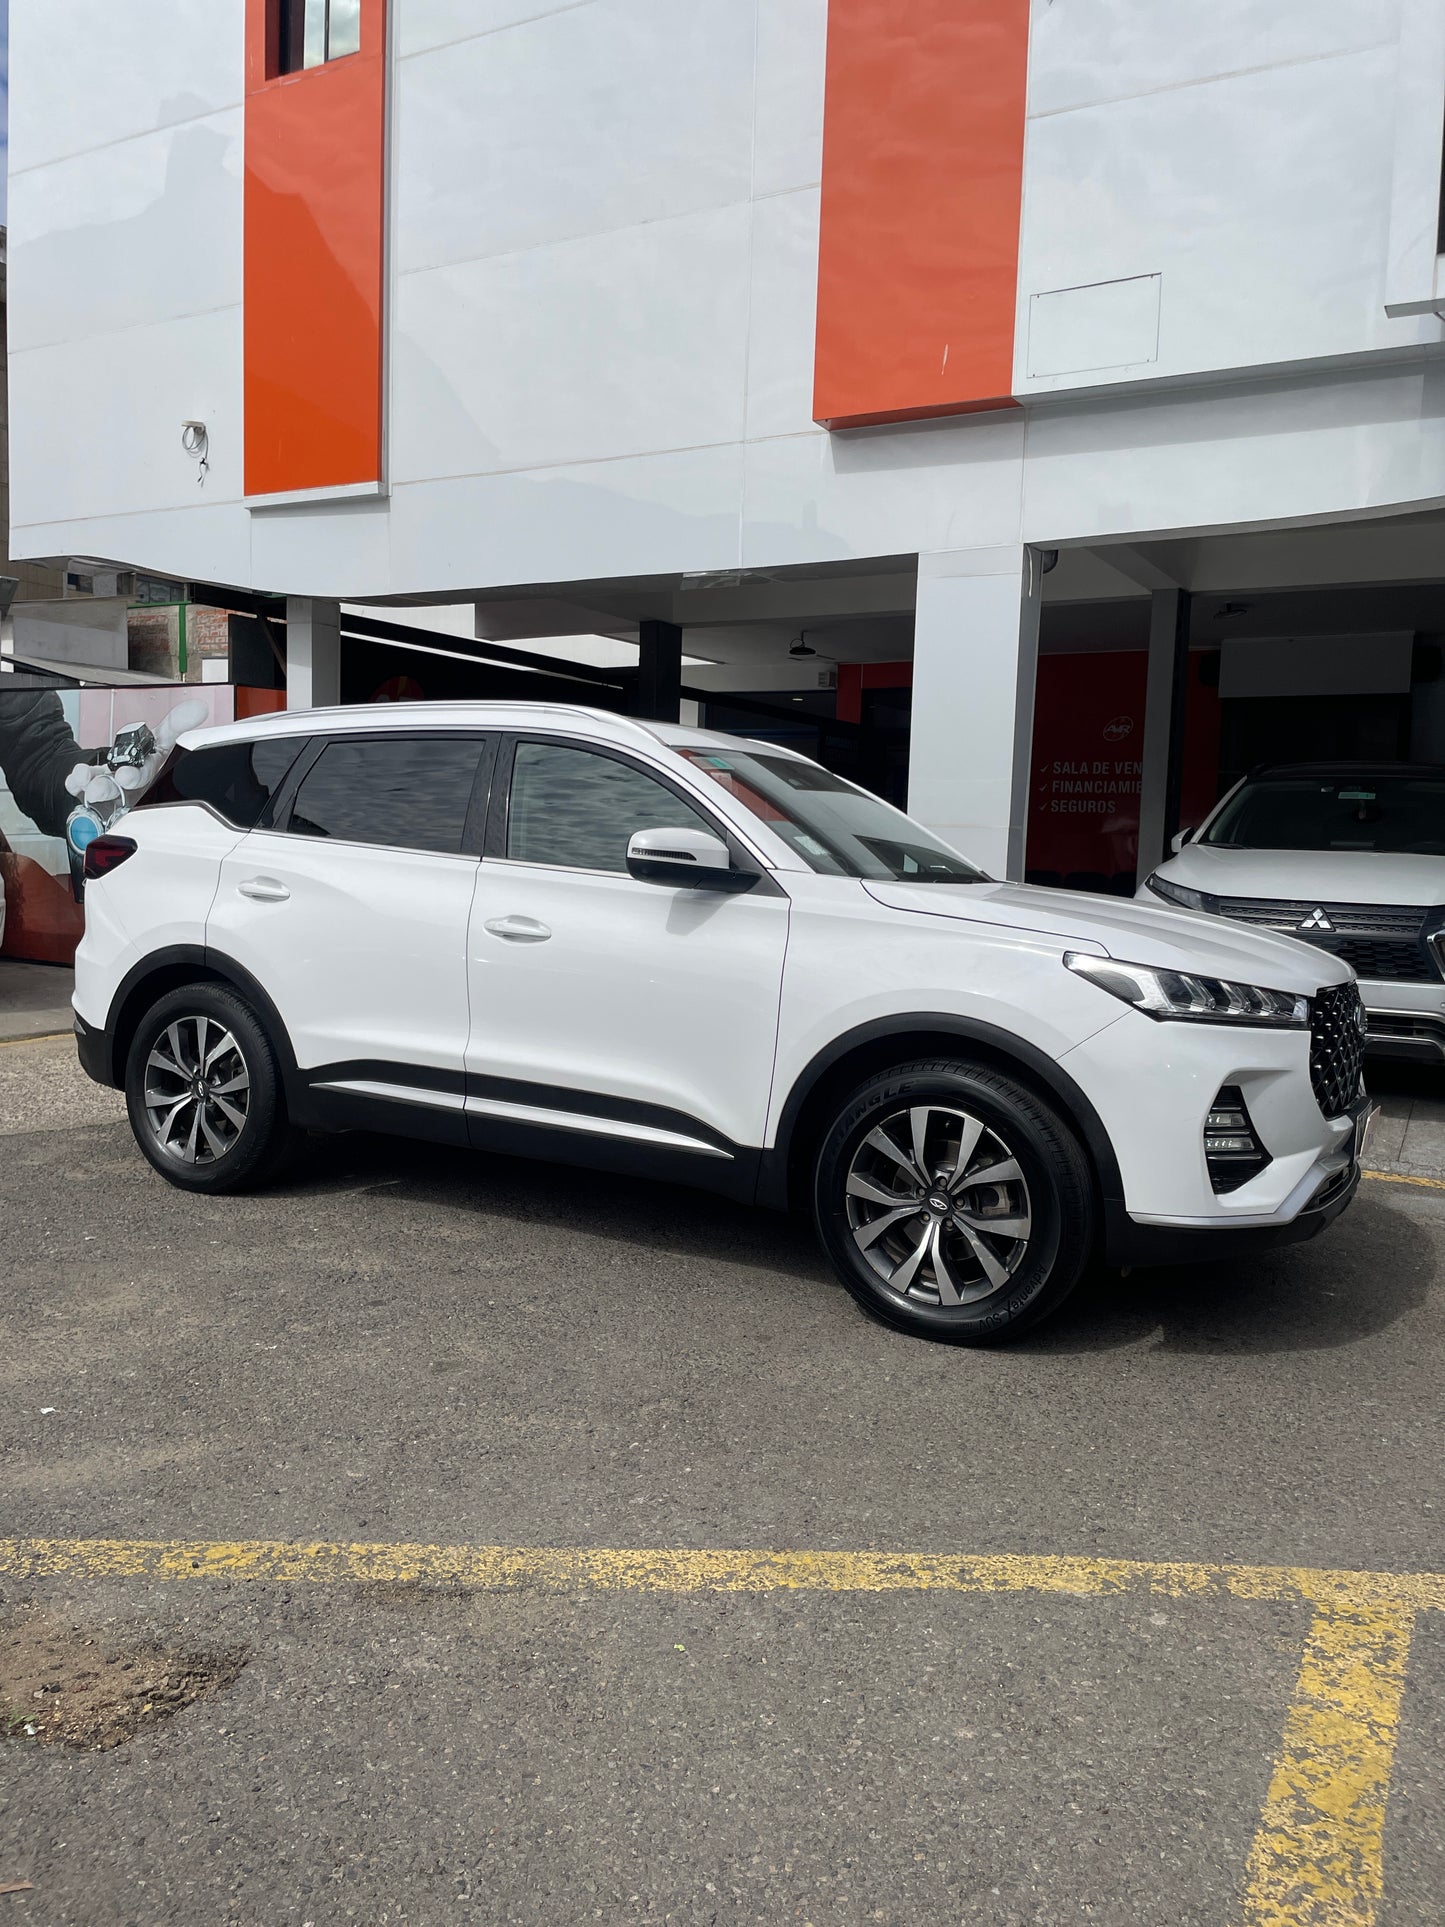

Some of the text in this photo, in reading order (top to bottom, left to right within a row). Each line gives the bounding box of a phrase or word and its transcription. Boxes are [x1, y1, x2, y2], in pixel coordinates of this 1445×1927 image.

[1053, 761, 1088, 774] SALA
[1093, 761, 1110, 774] DE
[1051, 800, 1116, 813] SEGUROS
[979, 1312, 1002, 1332] SUV
